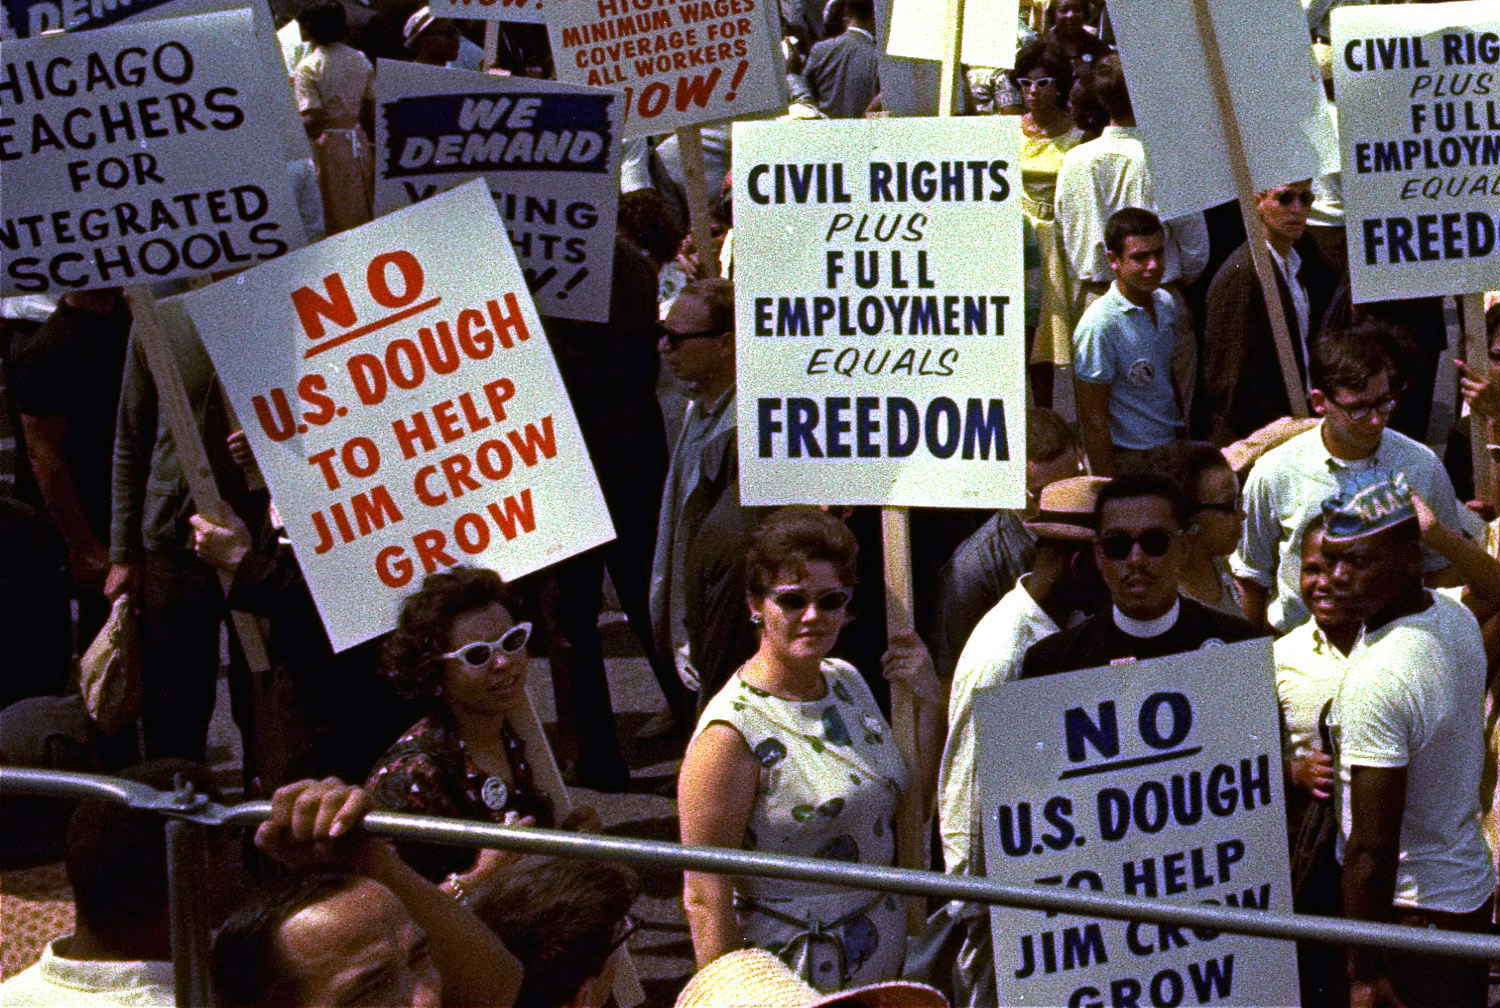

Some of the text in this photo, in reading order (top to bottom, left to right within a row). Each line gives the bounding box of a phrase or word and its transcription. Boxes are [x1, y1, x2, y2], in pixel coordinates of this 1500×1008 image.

[562, 10, 673, 47] MINIMUM
[575, 18, 752, 68] COVERAGE FOR
[586, 39, 748, 86] ALL WORKERS
[1344, 37, 1430, 72] CIVIL
[1410, 73, 1493, 97] PLUS
[457, 98, 543, 130] WE
[67, 152, 165, 192] FOR
[400, 131, 604, 168] DEMAND
[402, 180, 599, 228] VING
[747, 160, 1010, 205] CIVIL RIGHTS
[511, 236, 587, 264] HTS
[825, 213, 928, 242] PLUS
[7, 222, 288, 292] SCHOOLS
[827, 250, 935, 289] FULL
[290, 250, 425, 340] NO
[754, 296, 1010, 337] EMPLOYMENT
[252, 292, 531, 442] U.S. DOUGH
[807, 348, 959, 376] EQUALS
[308, 378, 516, 491] TO HELP
[757, 396, 1010, 461] FREEDOM
[311, 414, 559, 555] JIM CROW
[374, 489, 537, 589] GROW
[1065, 692, 1193, 763] NO
[1000, 754, 1272, 857] U.S. DOUGH
[1123, 839, 1246, 898] HELP
[1015, 924, 1108, 980] JIM
